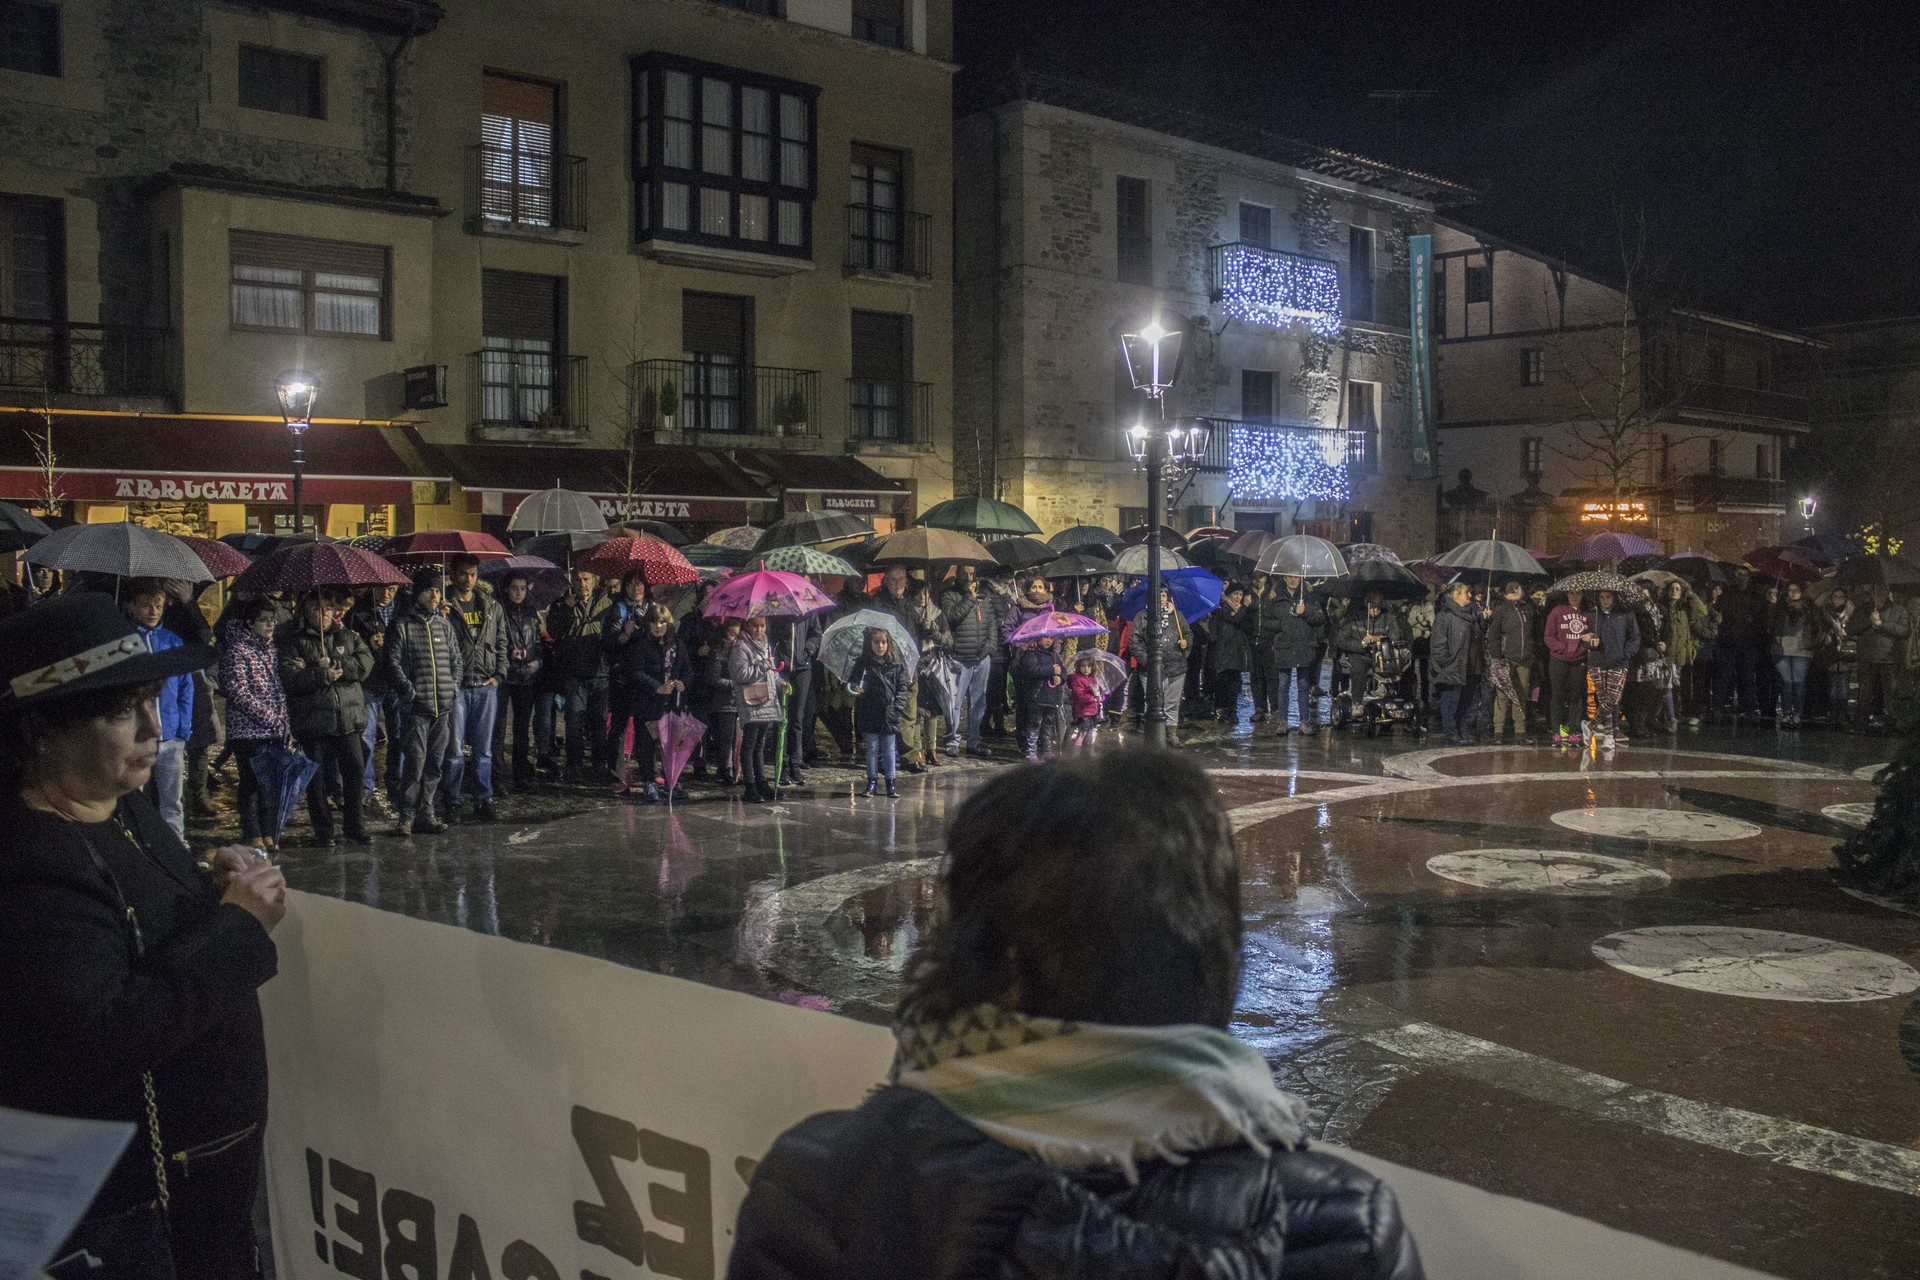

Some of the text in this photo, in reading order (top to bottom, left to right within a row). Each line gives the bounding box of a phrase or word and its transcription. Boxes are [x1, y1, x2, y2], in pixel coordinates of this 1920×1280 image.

[116, 478, 288, 501] ARRUGAETA
[599, 500, 690, 518] RUGAETA
[826, 498, 876, 508] ARRUGAETA
[1562, 613, 1587, 622] DUBLIN
